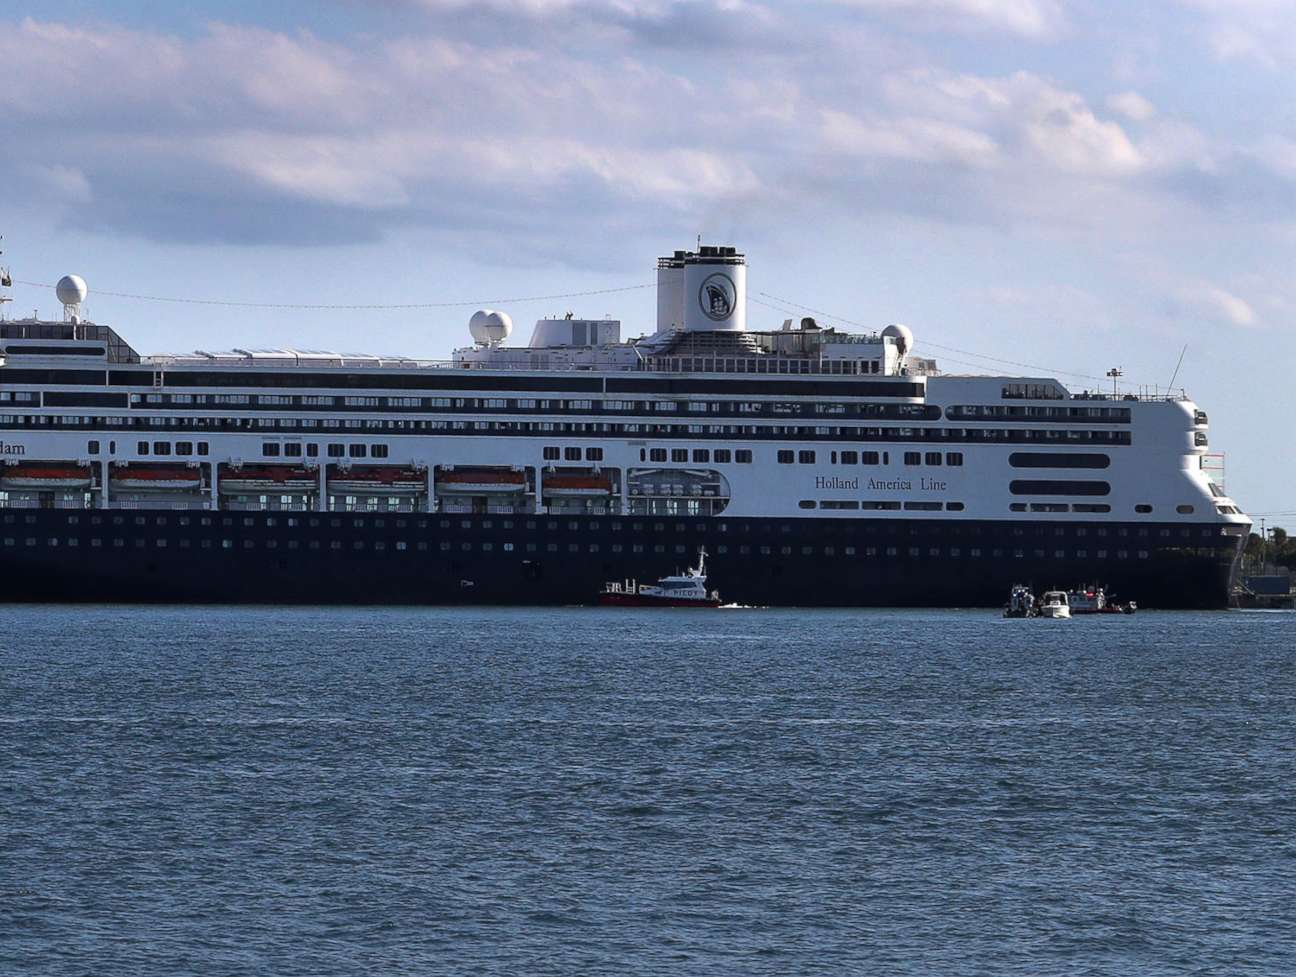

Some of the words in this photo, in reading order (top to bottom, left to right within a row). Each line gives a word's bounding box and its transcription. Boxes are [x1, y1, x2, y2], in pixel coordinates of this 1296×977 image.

[815, 476, 859, 489] Holland
[867, 477, 912, 490] America
[921, 477, 947, 490] Line
